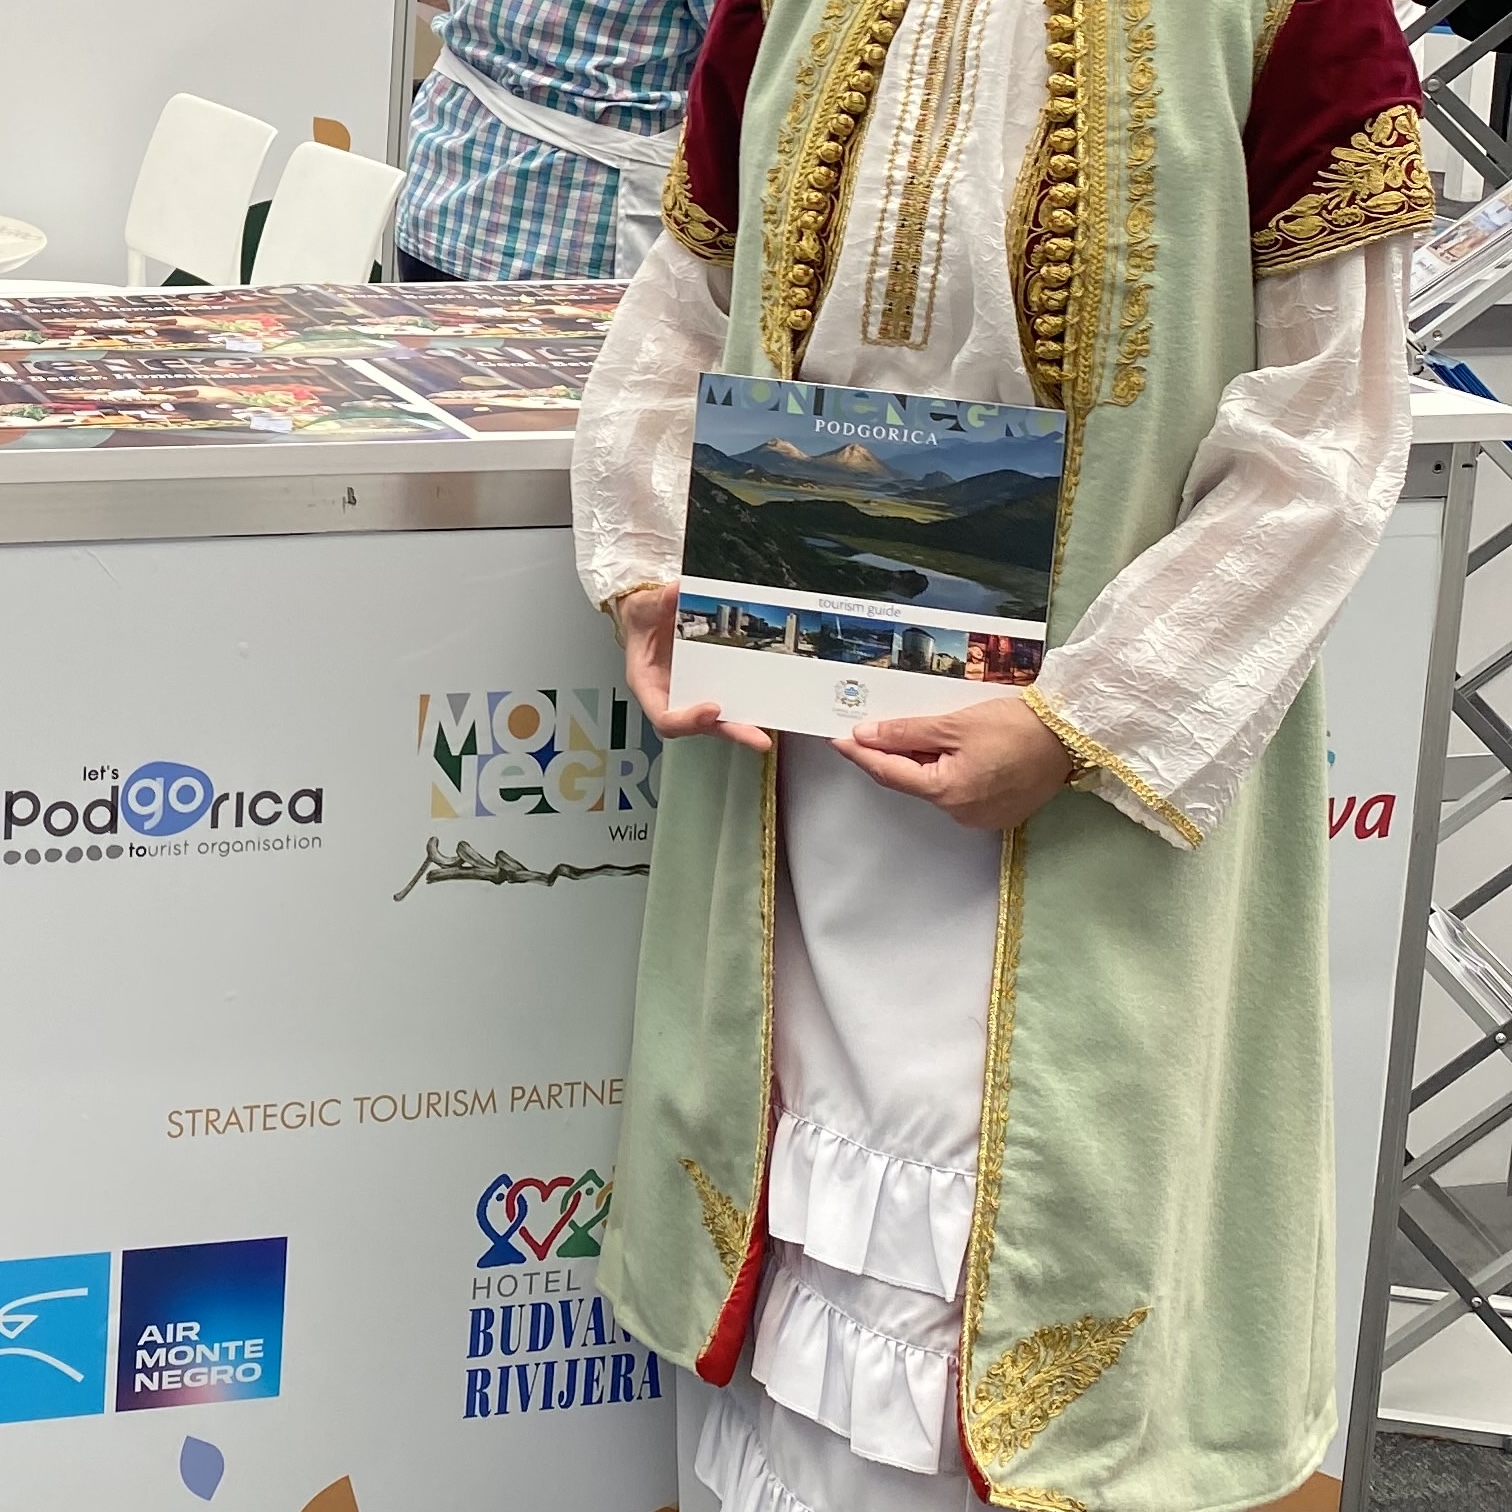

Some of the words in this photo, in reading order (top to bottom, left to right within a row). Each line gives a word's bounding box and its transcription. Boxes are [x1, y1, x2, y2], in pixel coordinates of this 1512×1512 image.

[814, 419, 939, 447] PODGORICA
[818, 597, 865, 615] tourism
[866, 604, 903, 621] guide
[418, 686, 662, 756] MONT
[82, 765, 120, 781] let's
[4, 775, 324, 841] podgorica
[129, 840, 190, 859] tourist
[197, 834, 323, 858] organisation
[608, 822, 648, 842] Wild
[166, 1097, 342, 1139] STRATEGIC
[353, 1087, 497, 1125] TOURISM
[471, 1269, 582, 1301] HOTEL
[137, 1321, 202, 1346] AIR
[135, 1338, 265, 1370] MONTE
[134, 1362, 263, 1394] NEGRO
[462, 1350, 663, 1420] RIVIJERA
